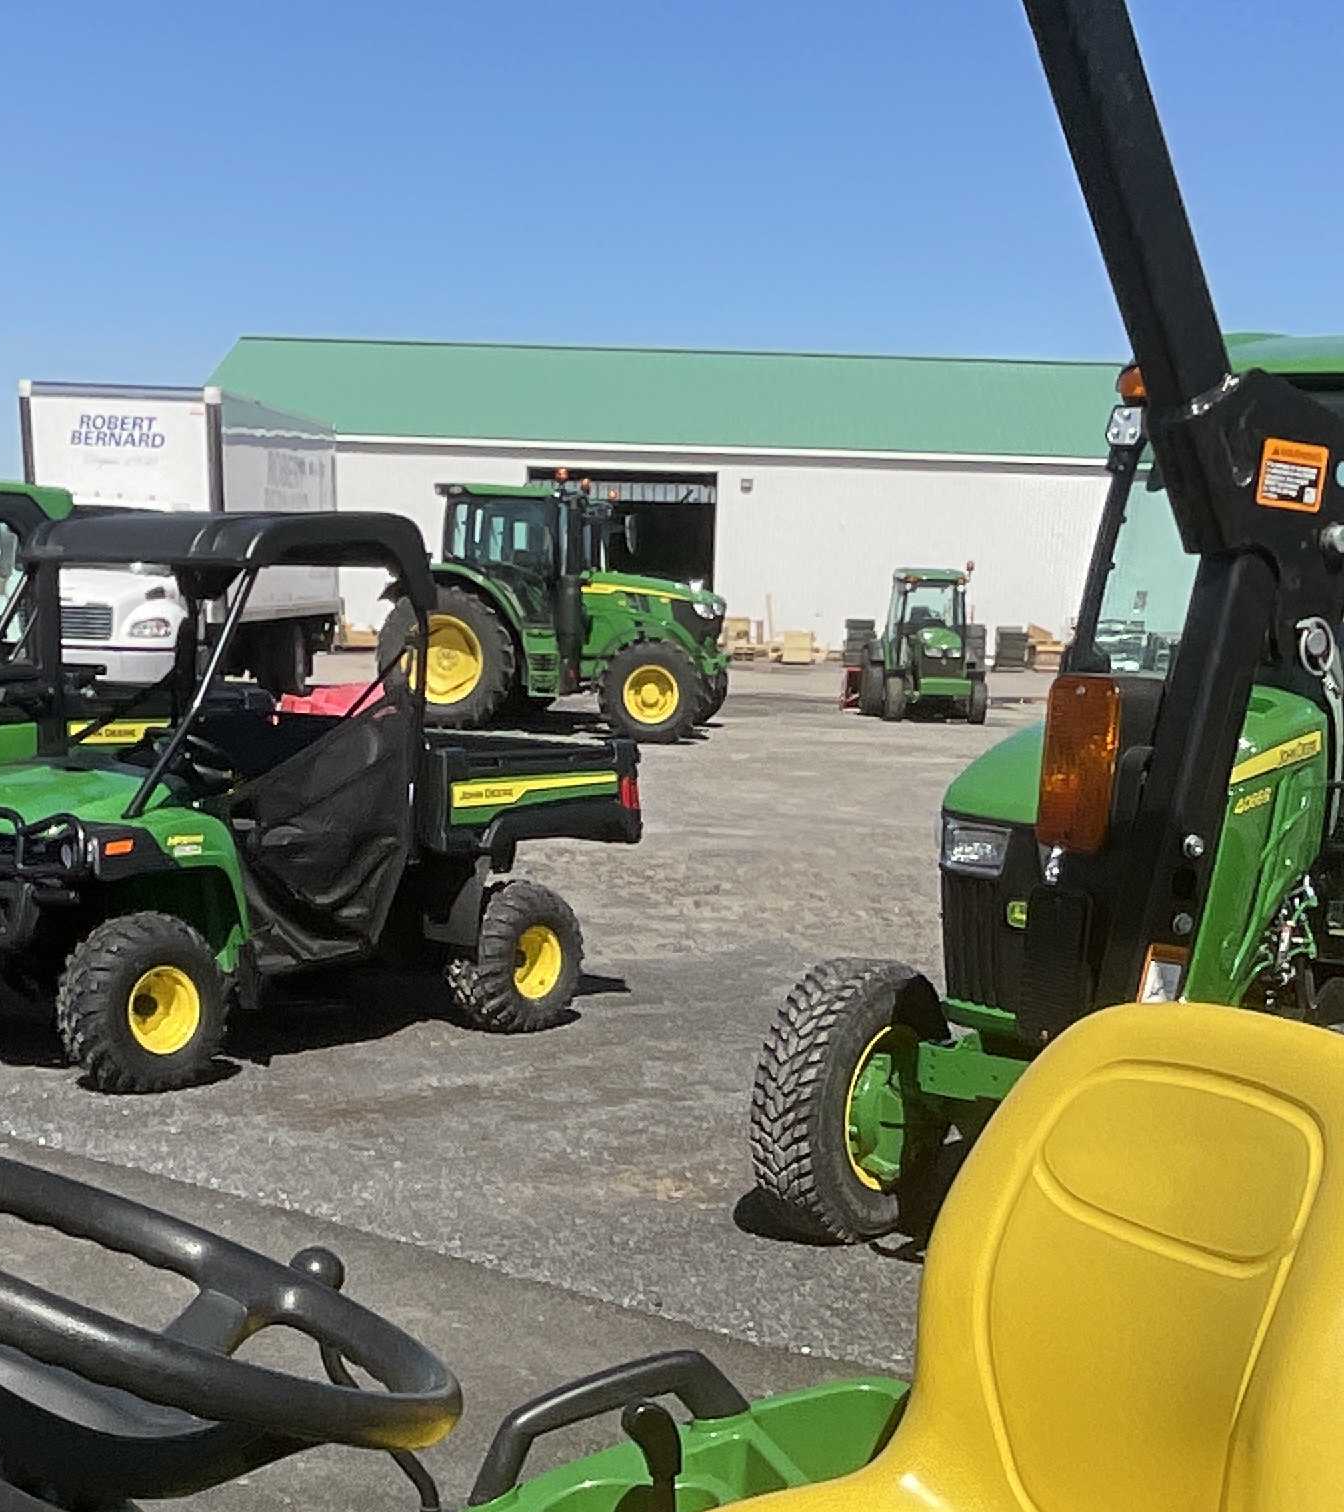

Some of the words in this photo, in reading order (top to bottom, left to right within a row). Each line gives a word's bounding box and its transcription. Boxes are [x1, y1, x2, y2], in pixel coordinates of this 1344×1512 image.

[78, 415, 157, 431] ROBERT
[70, 430, 166, 448] BERNARD
[484, 788, 513, 798] DEERE
